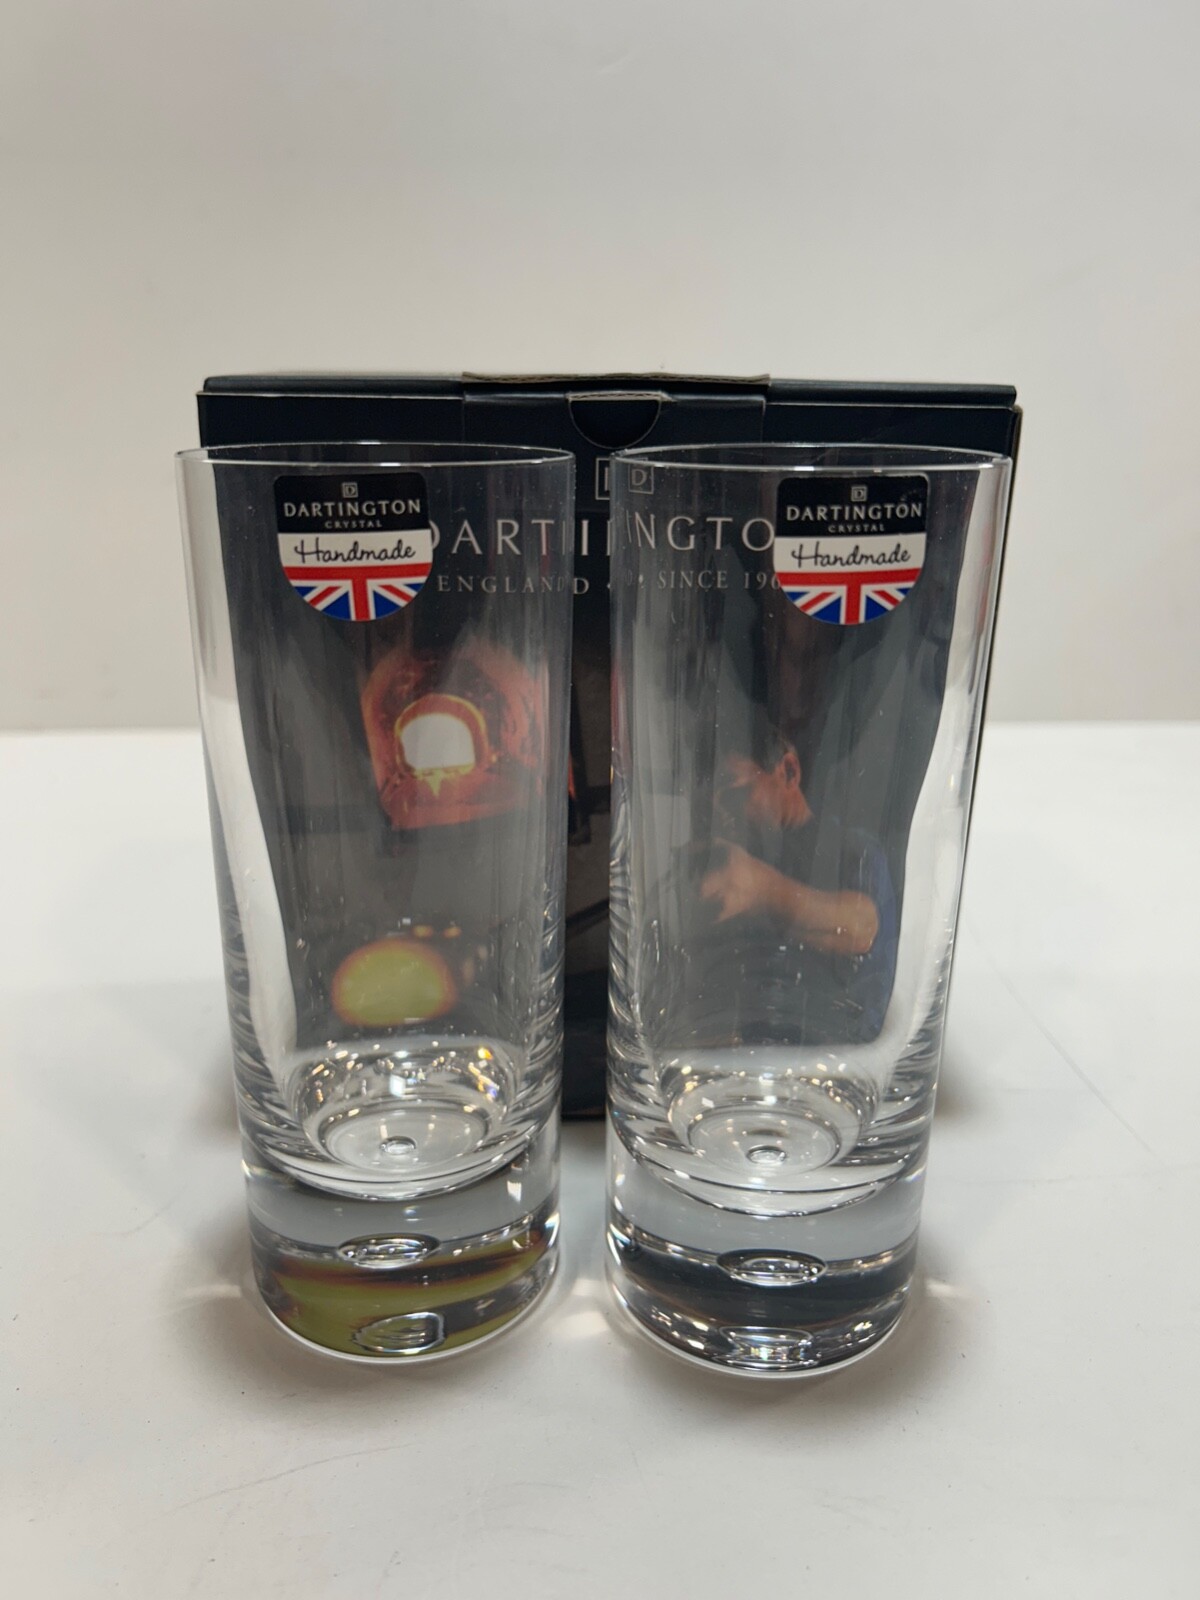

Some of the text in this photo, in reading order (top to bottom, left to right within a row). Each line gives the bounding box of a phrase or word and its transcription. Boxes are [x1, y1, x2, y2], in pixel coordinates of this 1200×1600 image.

[283, 499, 421, 517] DARTINGTON
[786, 503, 922, 521] DARTINGTON
[324, 519, 383, 529] CRYSTAL
[827, 523, 885, 533] CRYSTAL
[294, 537, 416, 563] Handmade
[791, 541, 911, 568] Handmade
[437, 570, 782, 594] ENGLAND SINCE 196
